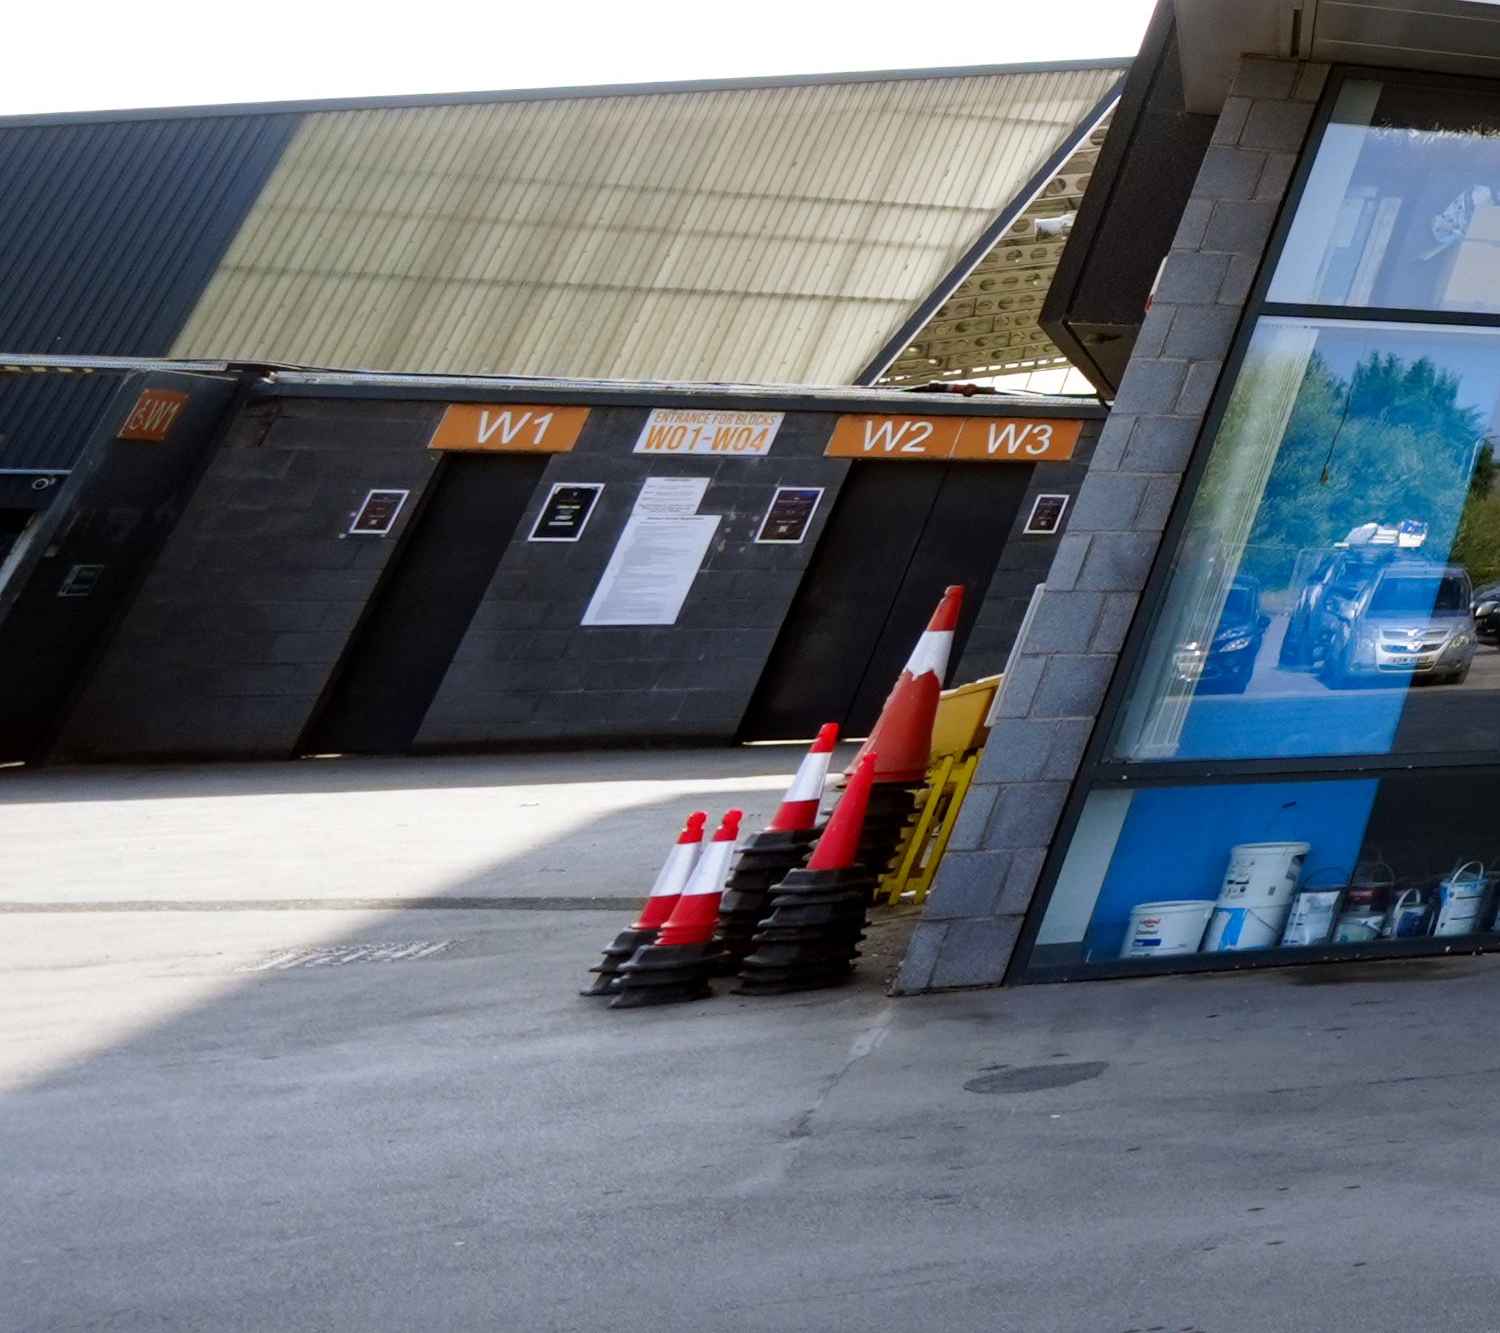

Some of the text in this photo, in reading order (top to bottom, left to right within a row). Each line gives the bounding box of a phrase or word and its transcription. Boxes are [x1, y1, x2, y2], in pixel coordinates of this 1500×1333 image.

[143, 399, 180, 433] W1
[475, 410, 555, 446] W1
[654, 411, 777, 426] ENTRANCE FOR BLOCKS
[863, 420, 934, 453] W2
[987, 422, 1053, 455] W3
